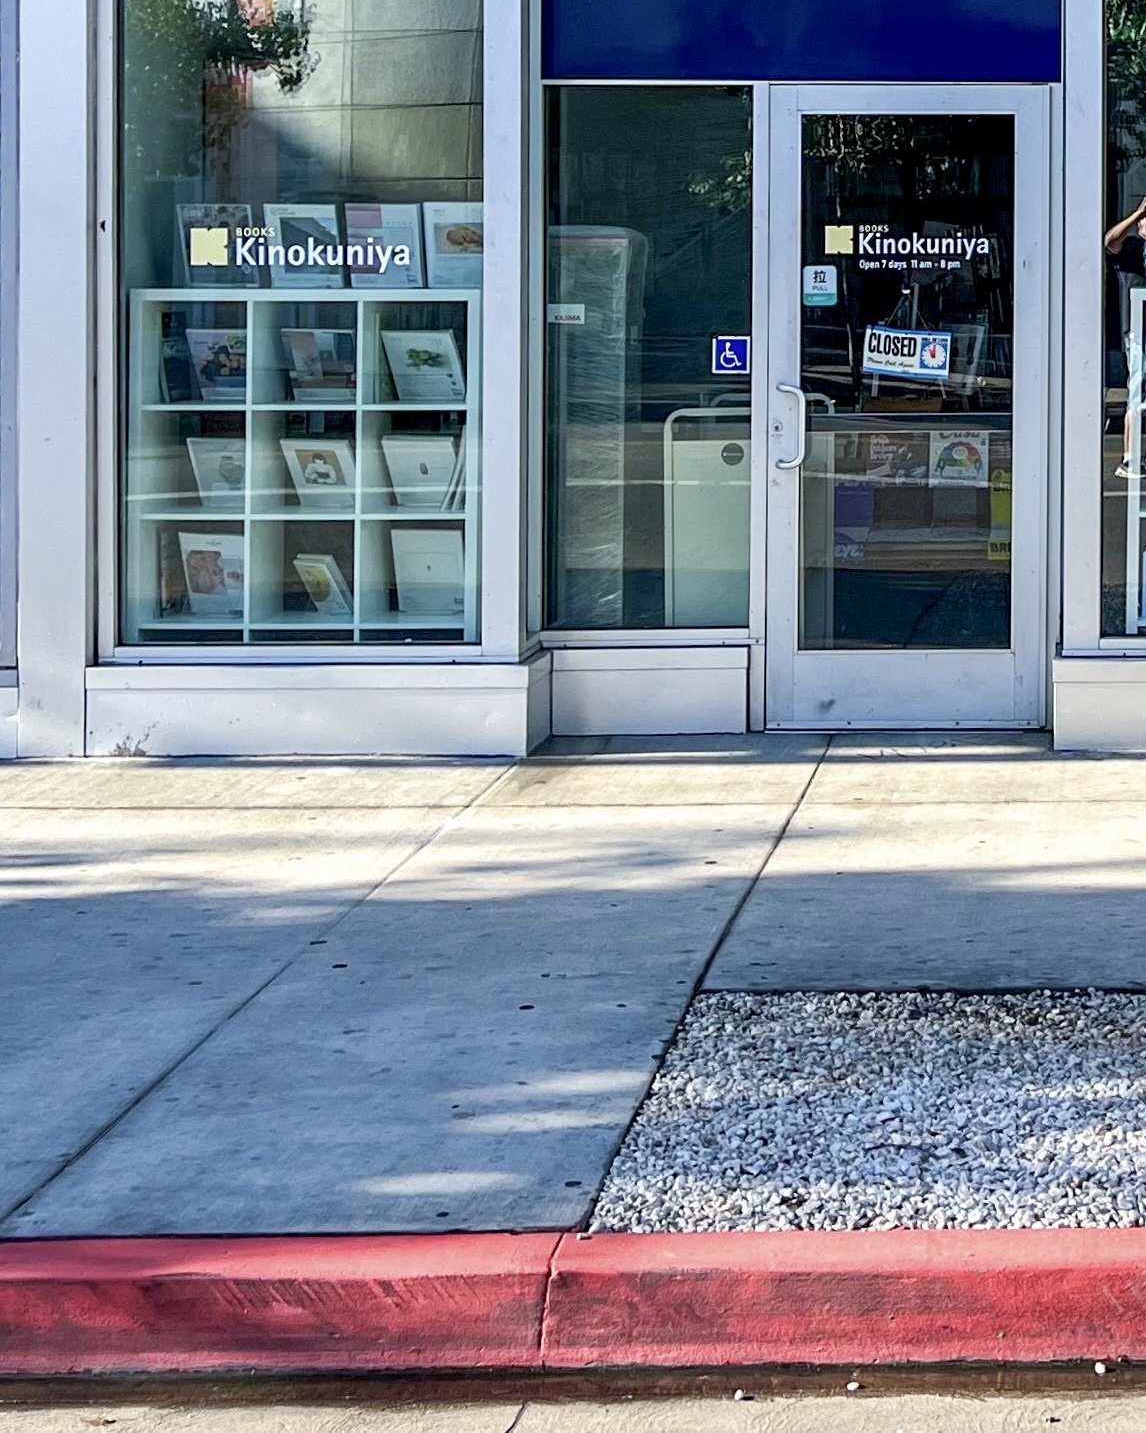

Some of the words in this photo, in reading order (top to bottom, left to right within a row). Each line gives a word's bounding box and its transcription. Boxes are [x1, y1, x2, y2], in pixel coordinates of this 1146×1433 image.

[235, 227, 276, 237] BOOKS
[858, 225, 890, 233] BOOKS
[858, 232, 990, 260] Kinokuniya
[235, 237, 411, 274] Kinokuniya
[859, 259, 880, 271] Open
[881, 259, 887, 268] 7
[888, 259, 908, 271] days
[910, 259, 918, 268] 11
[919, 260, 932, 268] am
[940, 259, 946, 269] 8
[947, 261, 961, 271] pm
[813, 270, 827, 283] 拉
[868, 332, 917, 357] CLOSED
